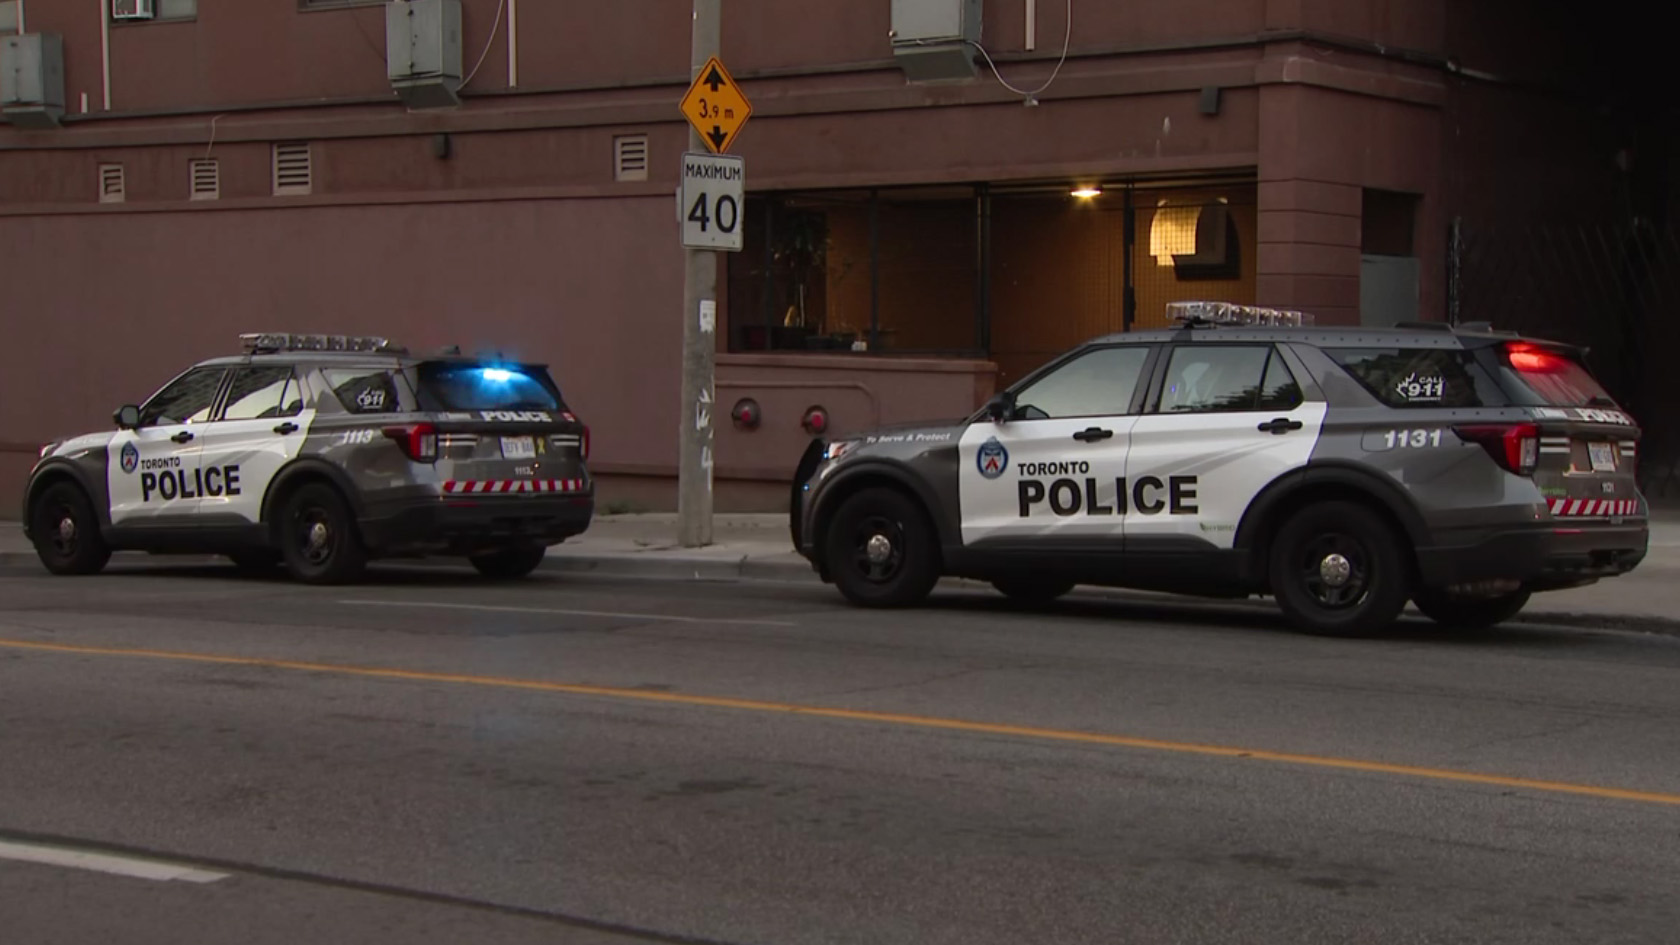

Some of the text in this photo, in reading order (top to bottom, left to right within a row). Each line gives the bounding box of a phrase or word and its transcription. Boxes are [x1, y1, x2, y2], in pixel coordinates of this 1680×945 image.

[724, 108, 734, 119] m
[685, 163, 741, 180] MAXIMUM
[687, 192, 738, 233] 40
[480, 411, 552, 422] POLICE
[342, 429, 374, 444] 1113
[867, 436, 876, 444] To
[879, 434, 904, 443] Serve
[916, 432, 951, 442] Protect
[1384, 429, 1441, 448] 1131
[141, 457, 180, 469] TORONTO
[1018, 461, 1089, 476] TORONTO
[141, 465, 241, 502] POLICE
[1018, 475, 1199, 517] POLICE
